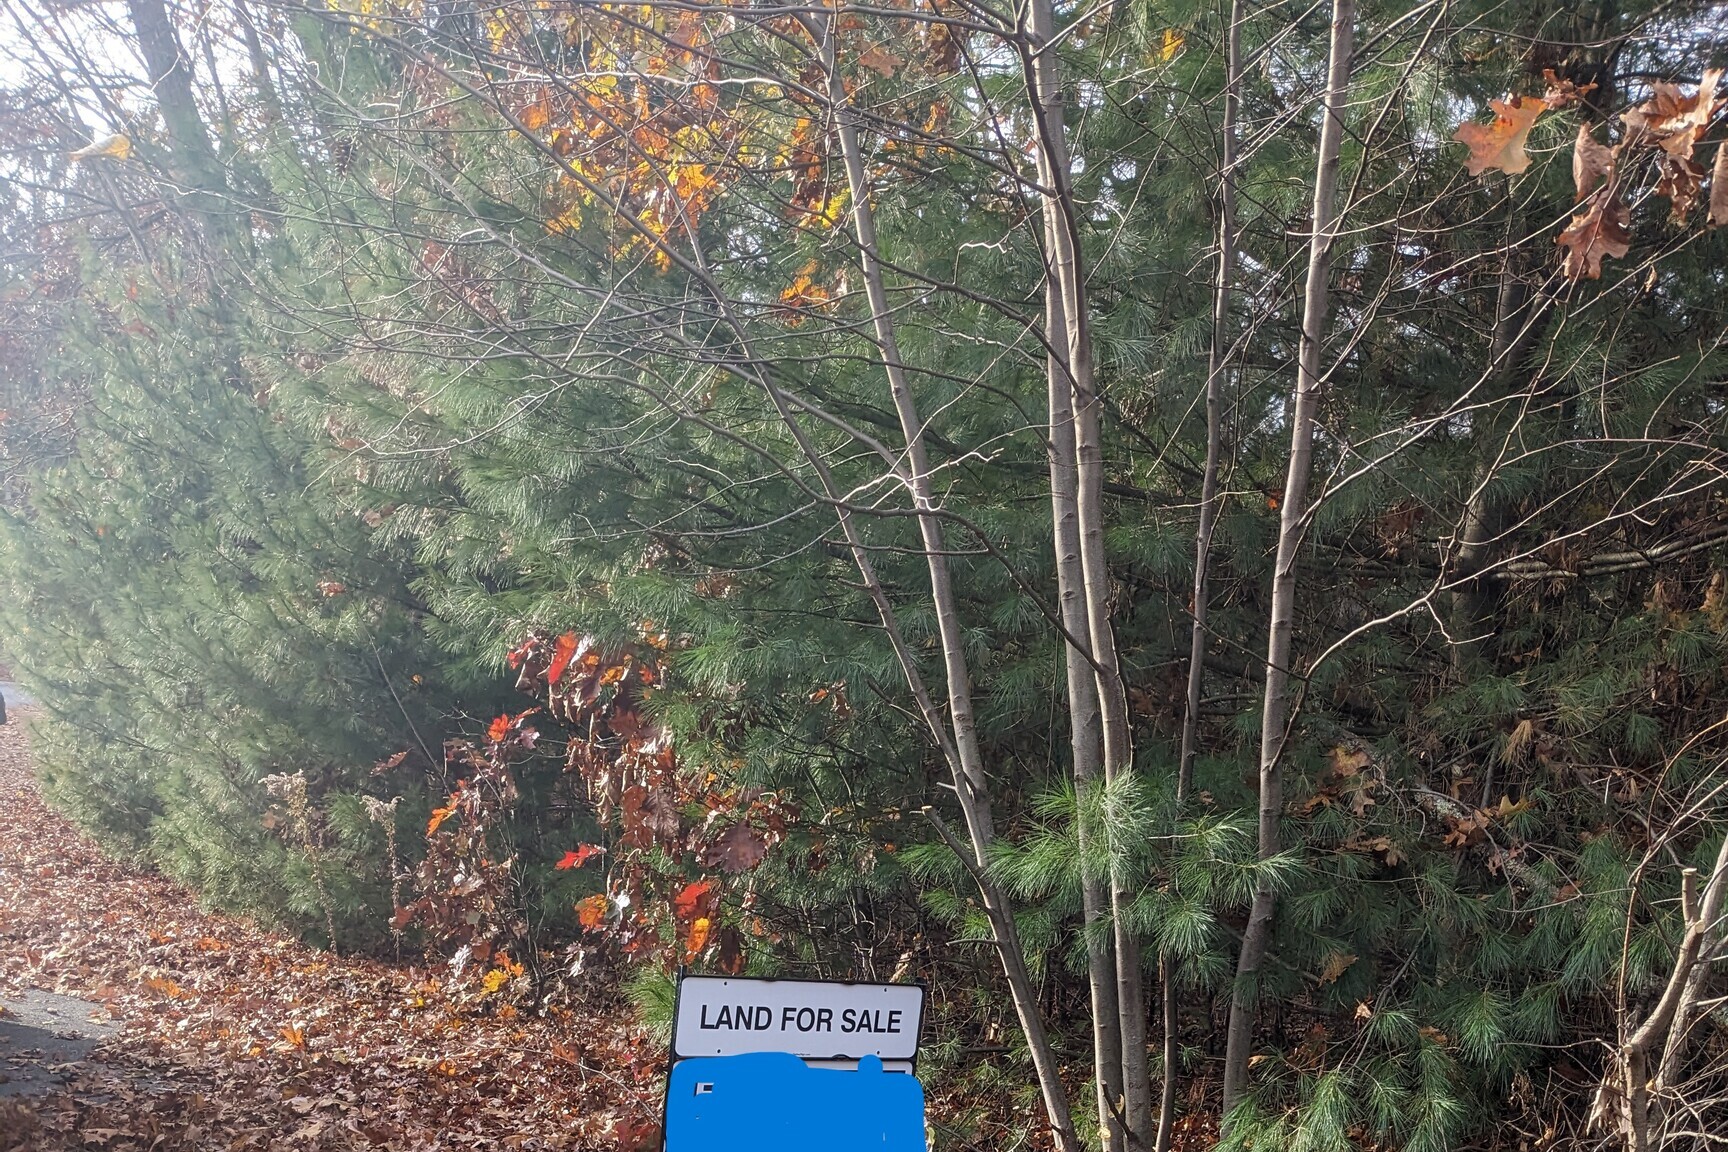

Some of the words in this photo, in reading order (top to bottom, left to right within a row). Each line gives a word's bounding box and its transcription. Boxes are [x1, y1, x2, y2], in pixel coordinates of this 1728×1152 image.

[700, 1004, 772, 1031] LAND
[780, 1006, 834, 1032] FOR
[840, 1008, 902, 1033] SALE
